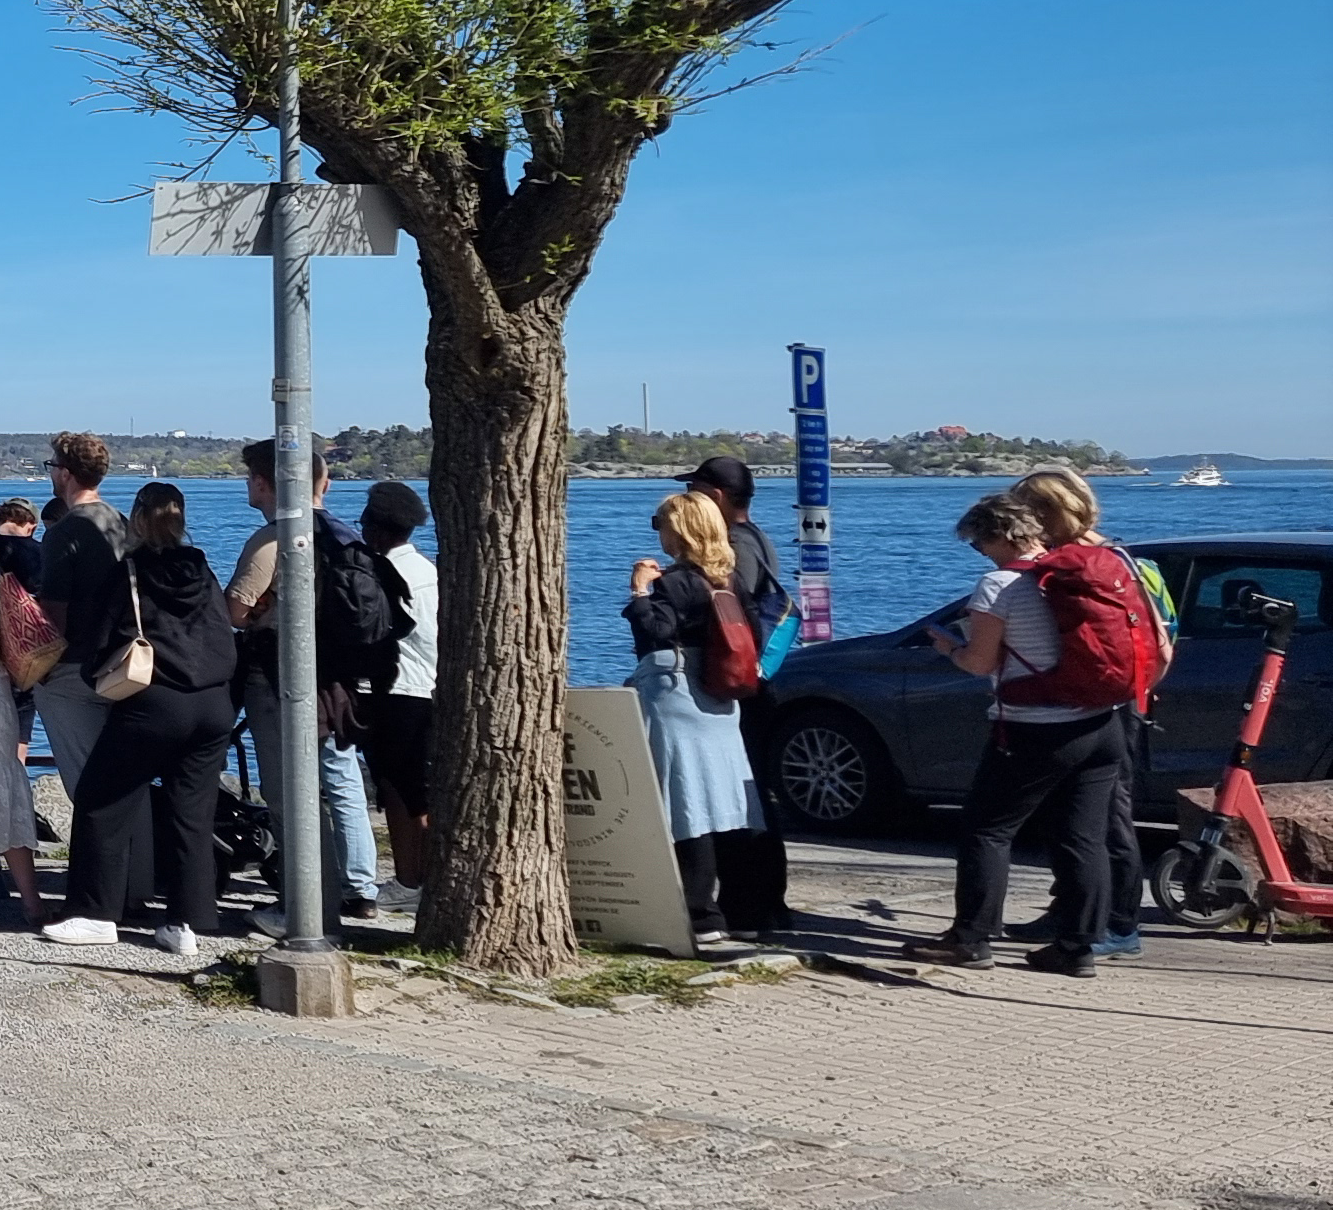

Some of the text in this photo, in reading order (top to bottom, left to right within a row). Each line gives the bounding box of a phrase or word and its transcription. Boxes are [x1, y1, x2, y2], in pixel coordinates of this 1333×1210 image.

[801, 355, 820, 404] P
[562, 769, 602, 802] EN
[563, 803, 596, 817] TRAND
